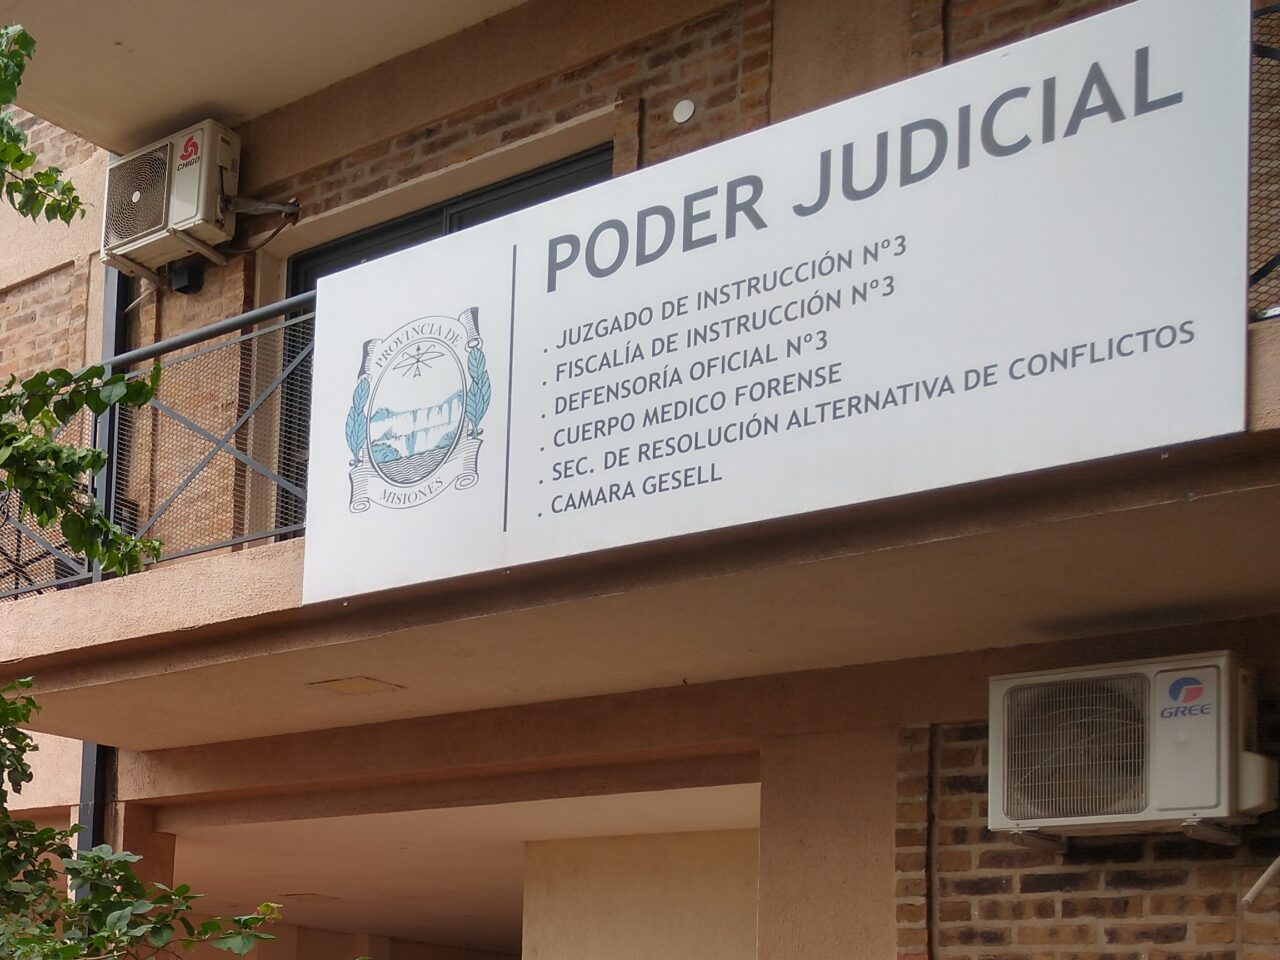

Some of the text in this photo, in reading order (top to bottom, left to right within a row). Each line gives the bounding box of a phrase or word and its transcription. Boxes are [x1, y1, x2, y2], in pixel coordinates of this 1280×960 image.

[177, 156, 200, 171] CHIGO
[547, 45, 1184, 293] PODER JUDICIAL
[556, 307, 653, 349] JUZGADO
[661, 296, 689, 321] DE
[697, 250, 853, 311] INSTRUCCIÓN
[376, 322, 463, 368] PROVINCIA DE
[555, 340, 644, 382] FISCALÍA
[651, 333, 678, 358] DE
[686, 289, 842, 349] INSTRUCCIÓN
[552, 320, 1195, 481] SEC. DE RESOLUCIÓN ALTERNATIVA DE CONFLICTOS
[553, 362, 842, 447] CUERPO MEDICO FORENSE
[554, 365, 683, 415] DEFENSORÍA
[689, 344, 778, 381] OFICIAL
[380, 478, 444, 506] MISIONES
[551, 462, 722, 514] CAMARA GESELL
[1160, 703, 1212, 718] GREE
